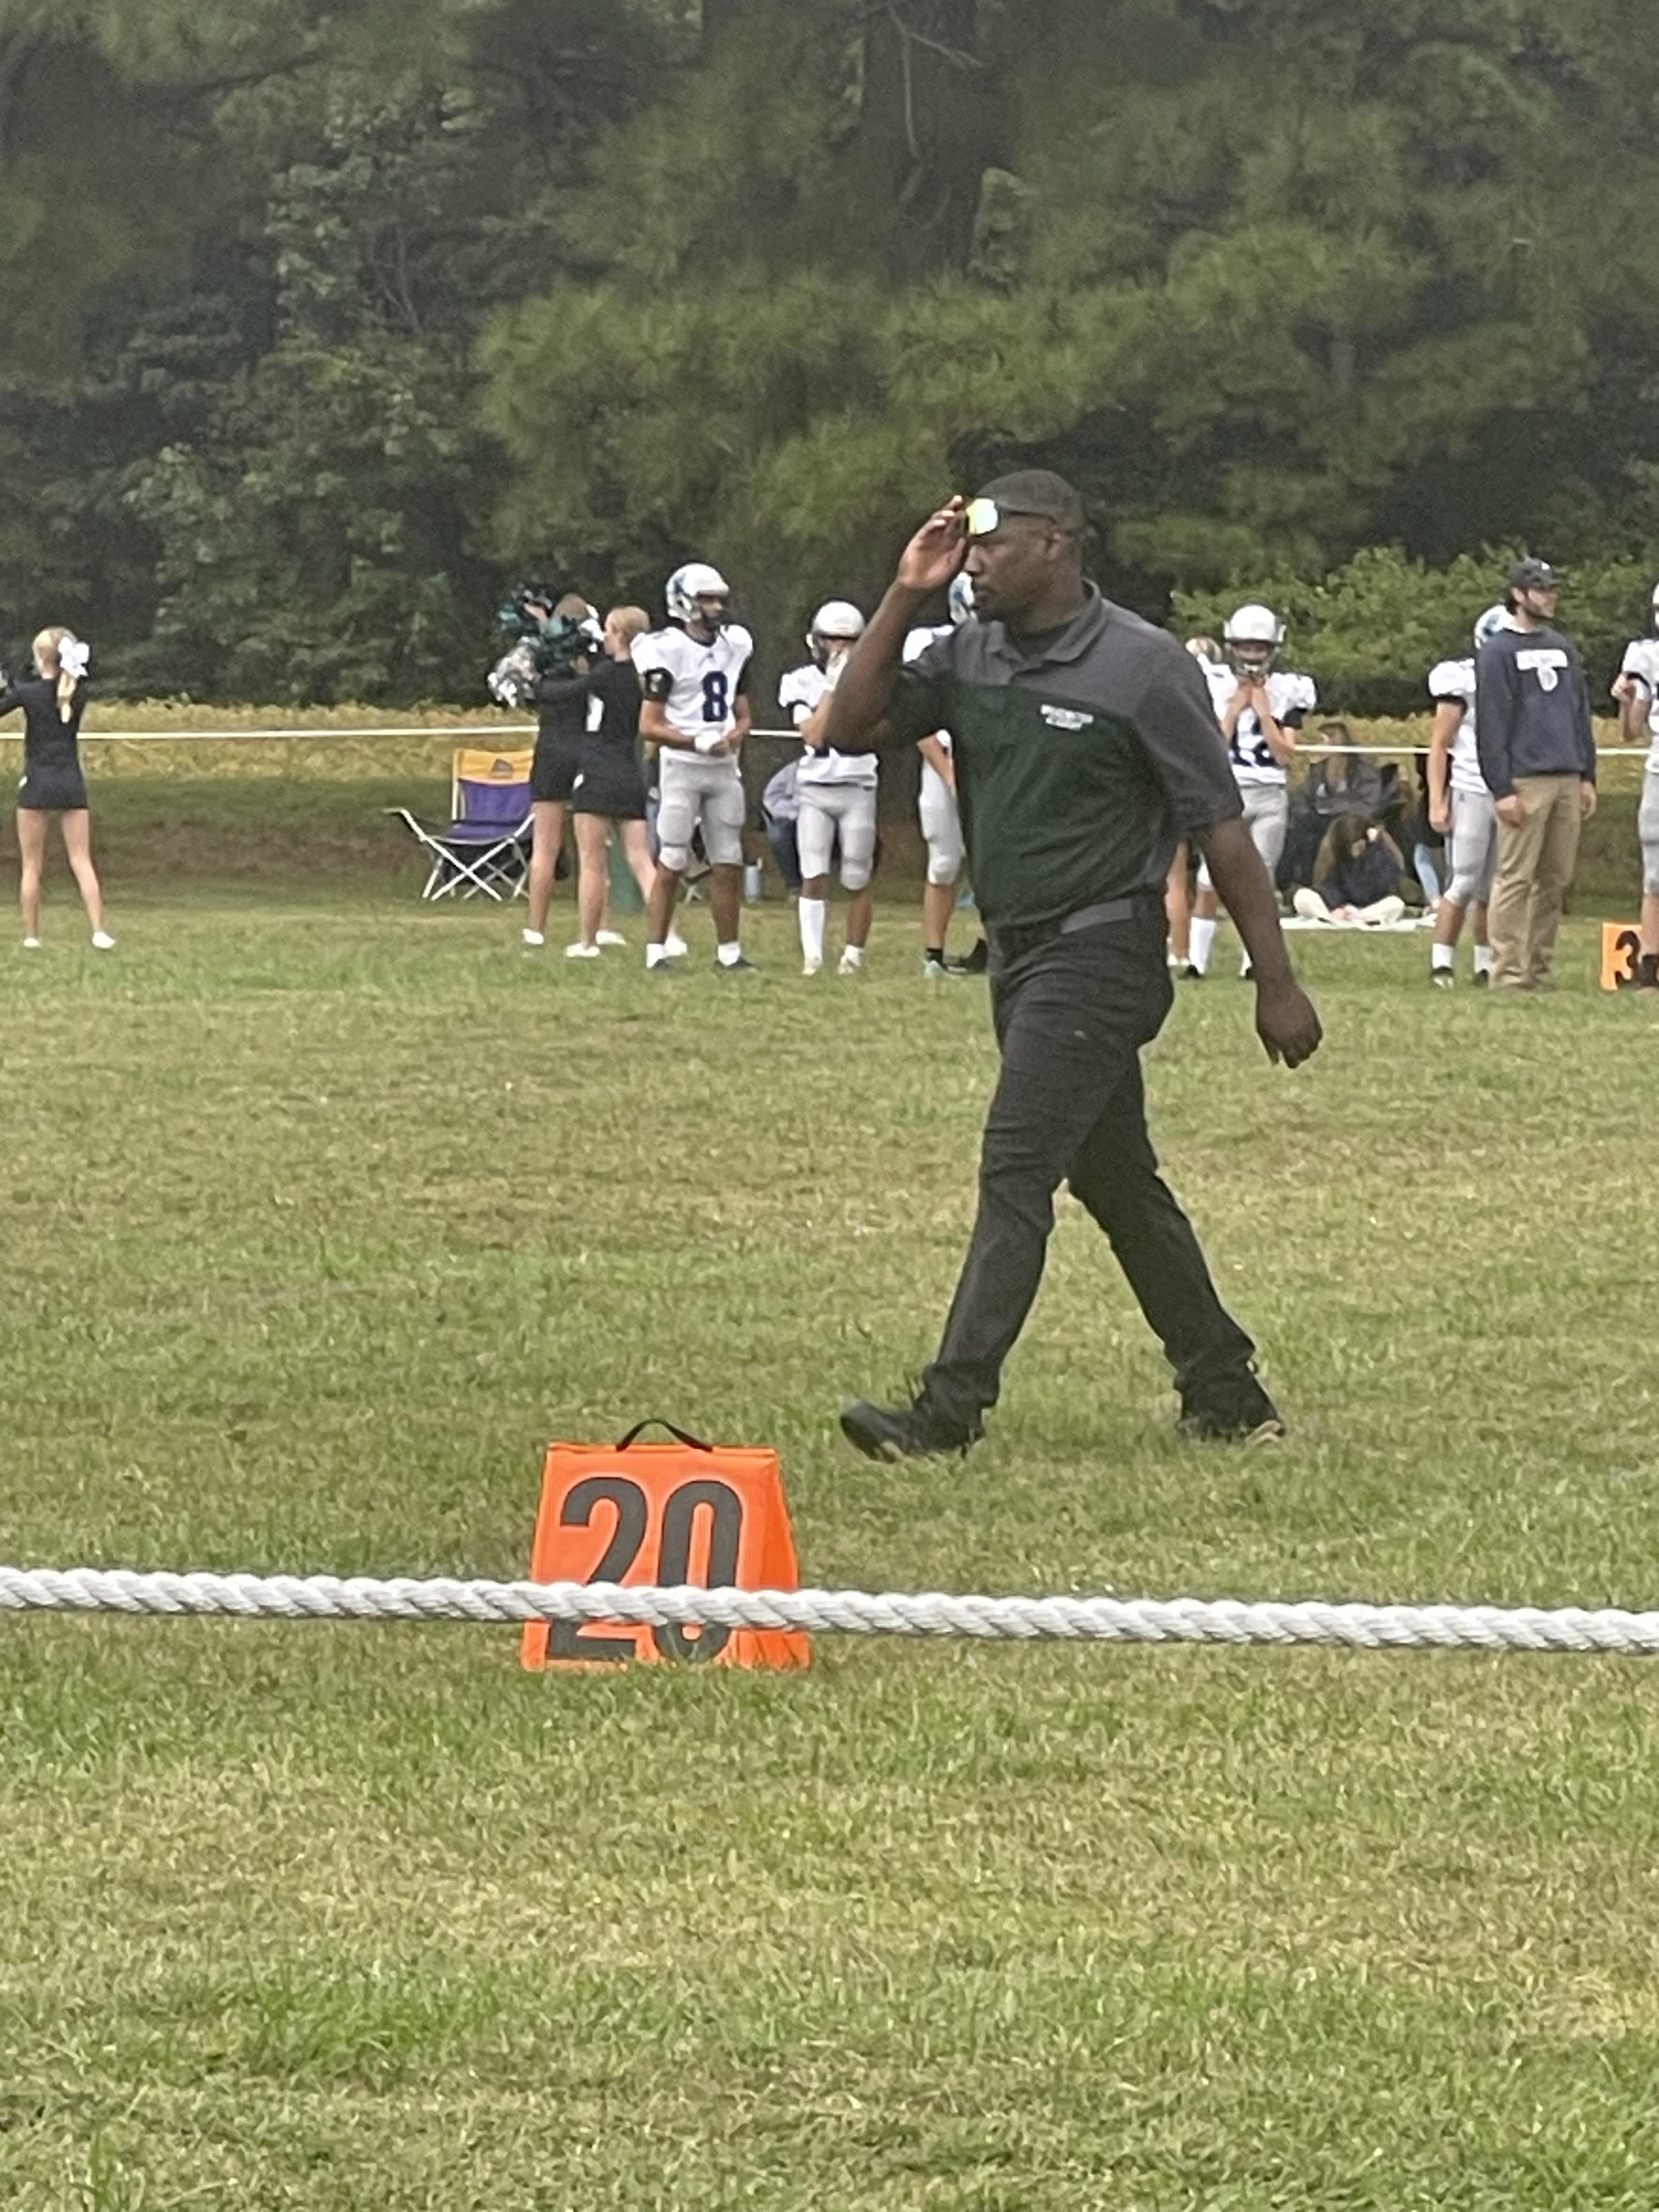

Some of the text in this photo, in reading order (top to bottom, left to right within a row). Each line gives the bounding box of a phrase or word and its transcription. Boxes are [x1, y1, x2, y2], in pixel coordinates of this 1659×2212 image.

[702, 670, 729, 722] 8
[1615, 929, 1641, 987] 3
[546, 1476, 743, 1663] 20
